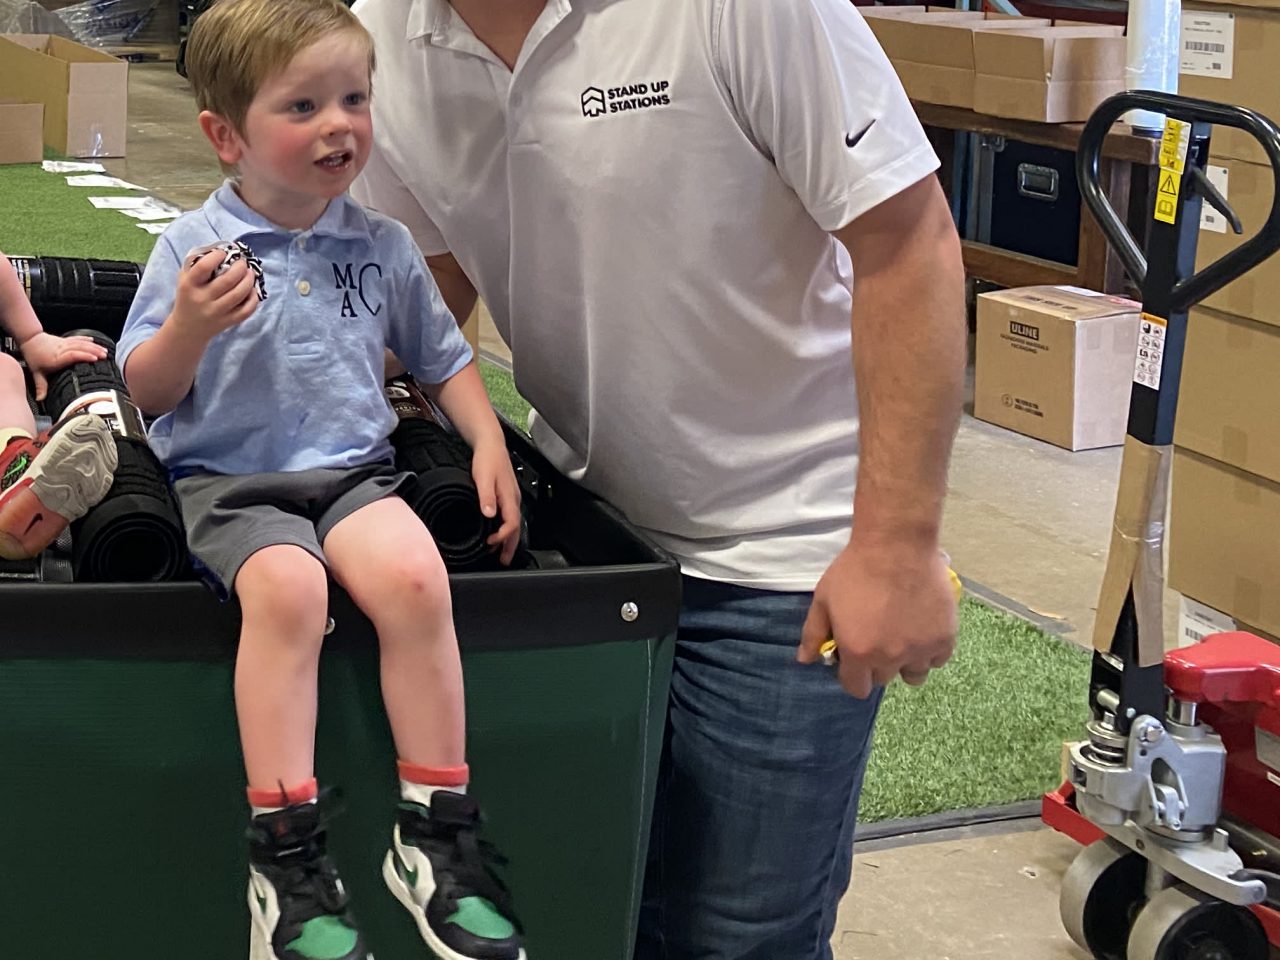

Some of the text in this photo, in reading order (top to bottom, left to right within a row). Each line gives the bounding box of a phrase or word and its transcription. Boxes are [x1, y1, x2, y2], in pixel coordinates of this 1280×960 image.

[607, 80, 669, 100] STAND UP
[609, 94, 671, 113] STATIONS
[1011, 322, 1039, 339] ULINE
